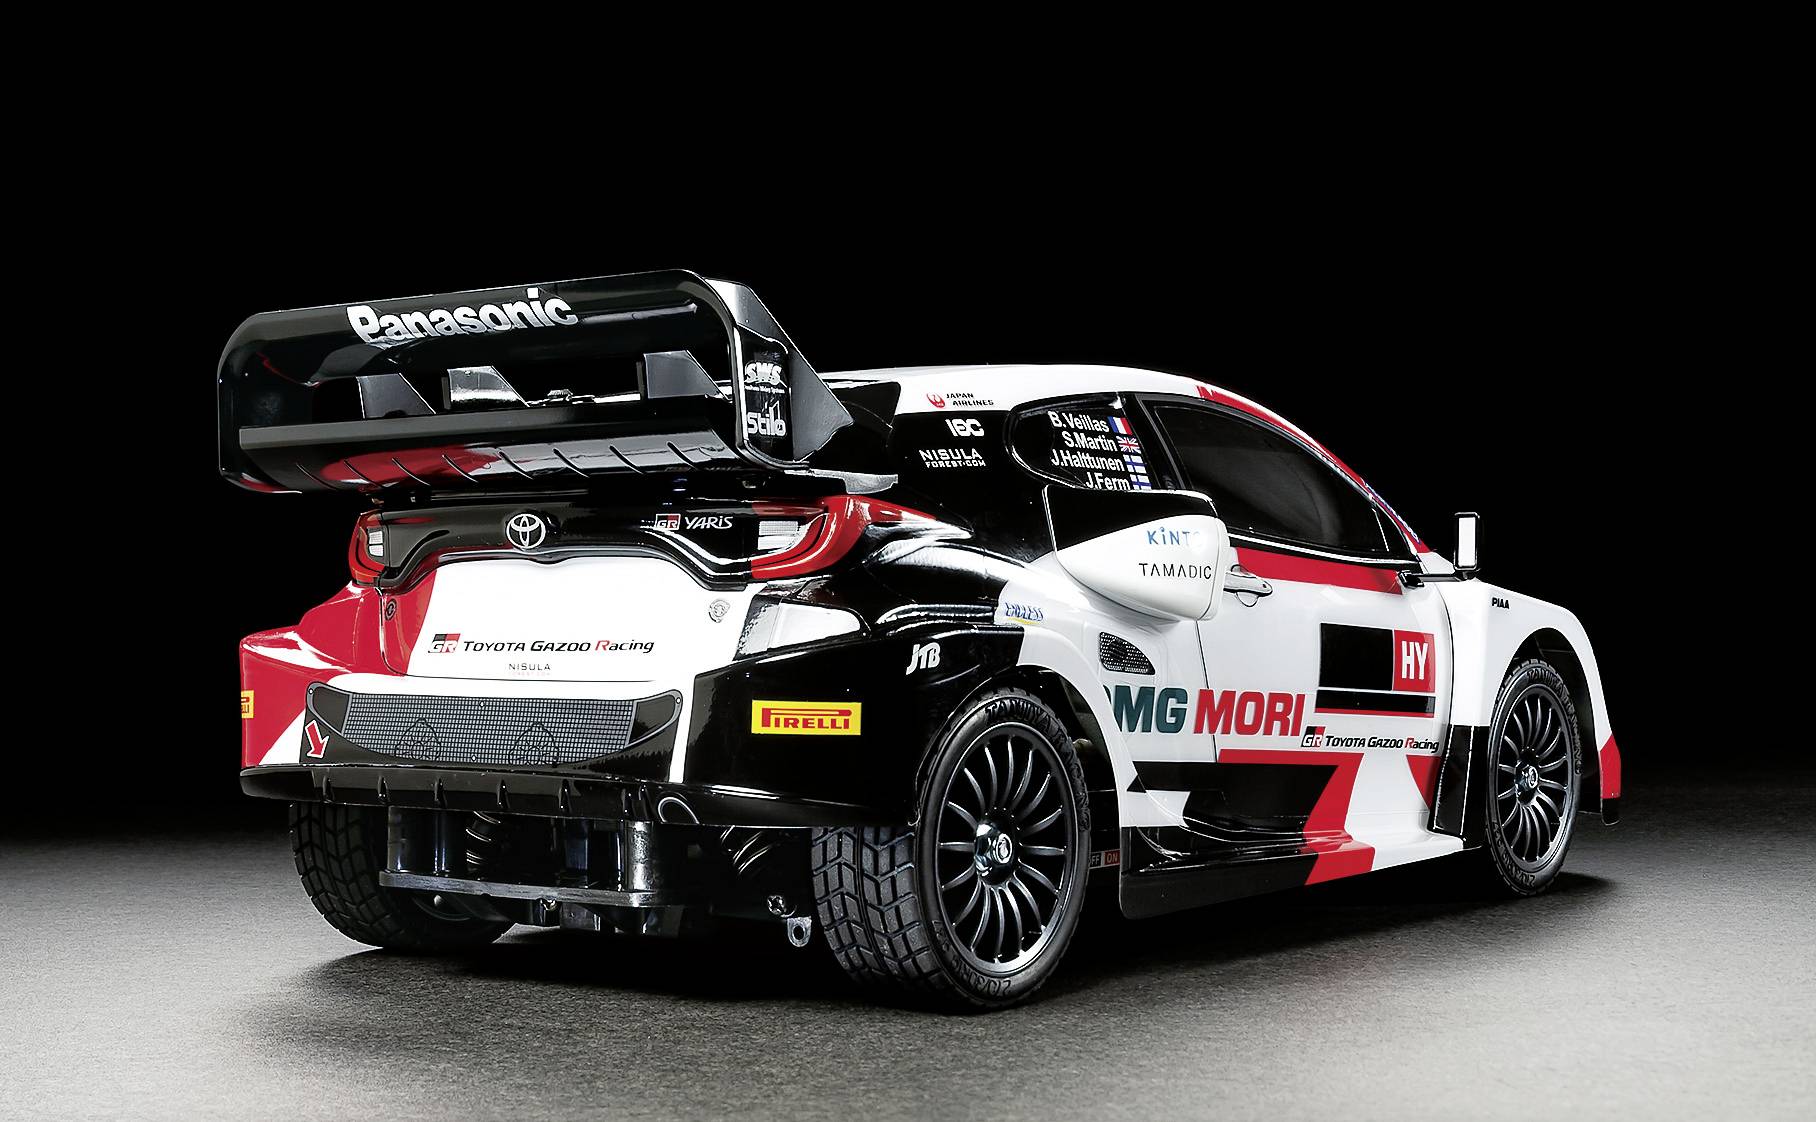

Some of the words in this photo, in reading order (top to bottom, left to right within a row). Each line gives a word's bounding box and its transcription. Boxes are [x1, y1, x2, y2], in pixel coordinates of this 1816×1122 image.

[346, 287, 579, 344] Panasonic
[744, 361, 782, 385] SWS
[1047, 410, 1110, 433] B.Veillas
[1061, 430, 1119, 452] S.Martin
[918, 448, 983, 461] NISULA
[1050, 448, 1126, 472] J.Halttunen
[1085, 471, 1131, 491] J.Ferm
[1138, 562, 1212, 580] TAMADIC
[1491, 597, 1510, 609] PIAA
[463, 640, 526, 652] TOYOTA
[530, 640, 591, 652] GAZOO
[595, 639, 655, 654] Racing
[508, 662, 552, 671] NISULA
[905, 641, 941, 676] JTB
[1401, 640, 1429, 681] HY
[761, 707, 853, 730] PIRELLI
[1102, 684, 1189, 734] MG
[1193, 688, 1306, 737] MORI
[1325, 735, 1366, 748] TOYOTA
[1367, 736, 1404, 749] GAZOO
[1404, 738, 1440, 754] Racing
[1106, 852, 1118, 863] ON
